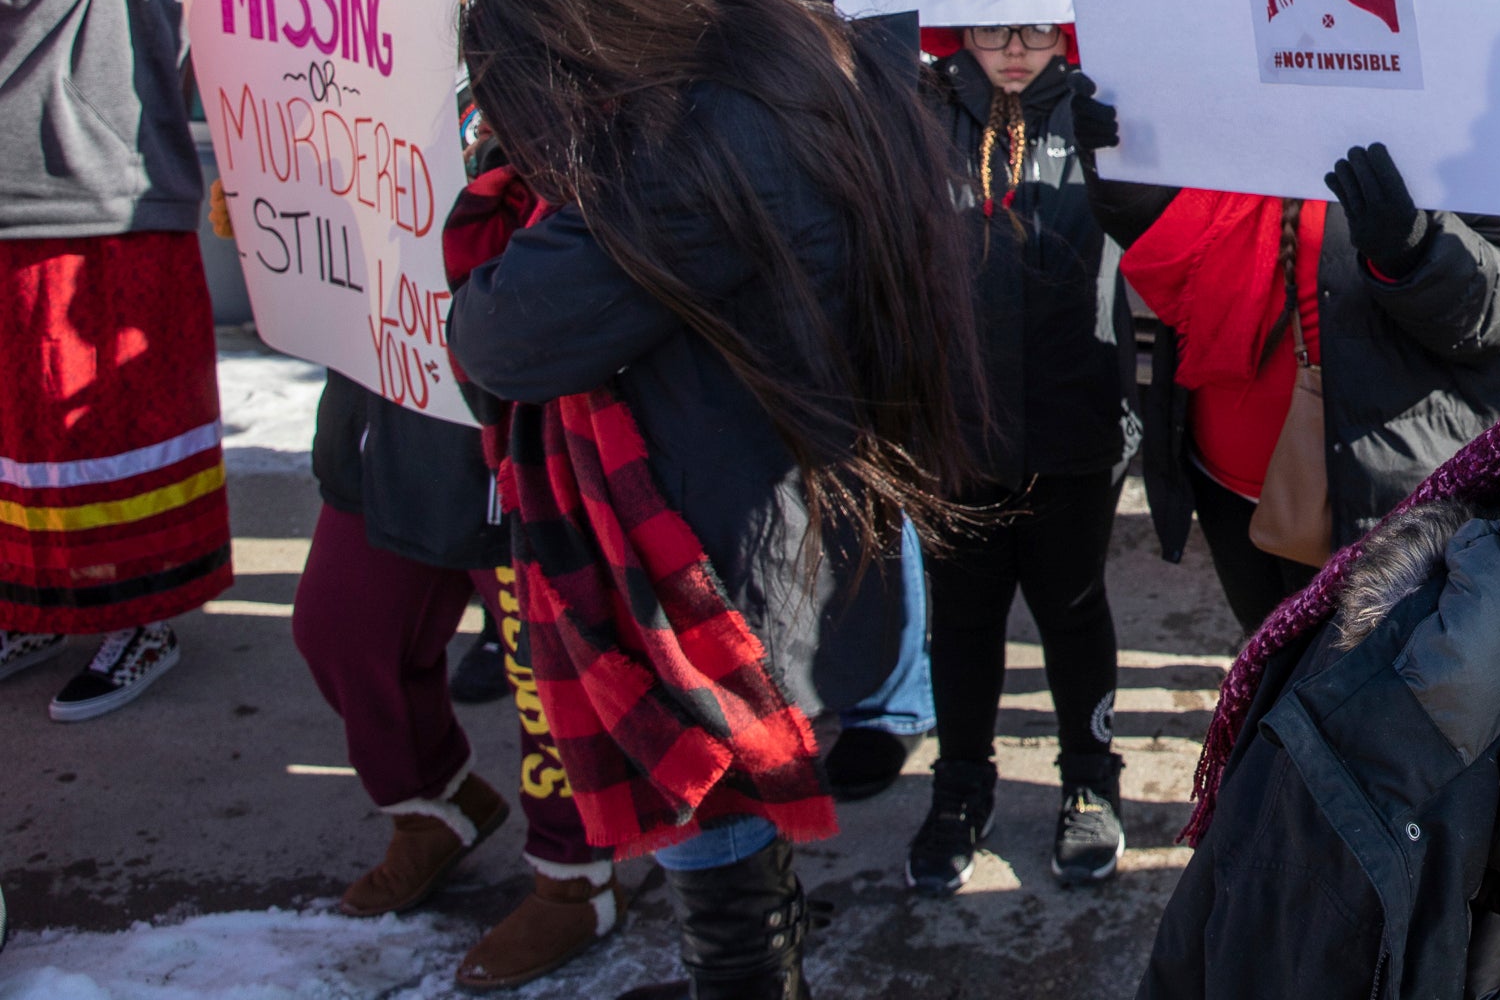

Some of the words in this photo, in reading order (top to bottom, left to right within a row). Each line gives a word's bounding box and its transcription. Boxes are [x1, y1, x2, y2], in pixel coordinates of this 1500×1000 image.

[218, 83, 435, 239] MURDERED
[252, 197, 364, 293] STILL
[377, 259, 453, 349] LOVE
[368, 314, 430, 411] YOU
